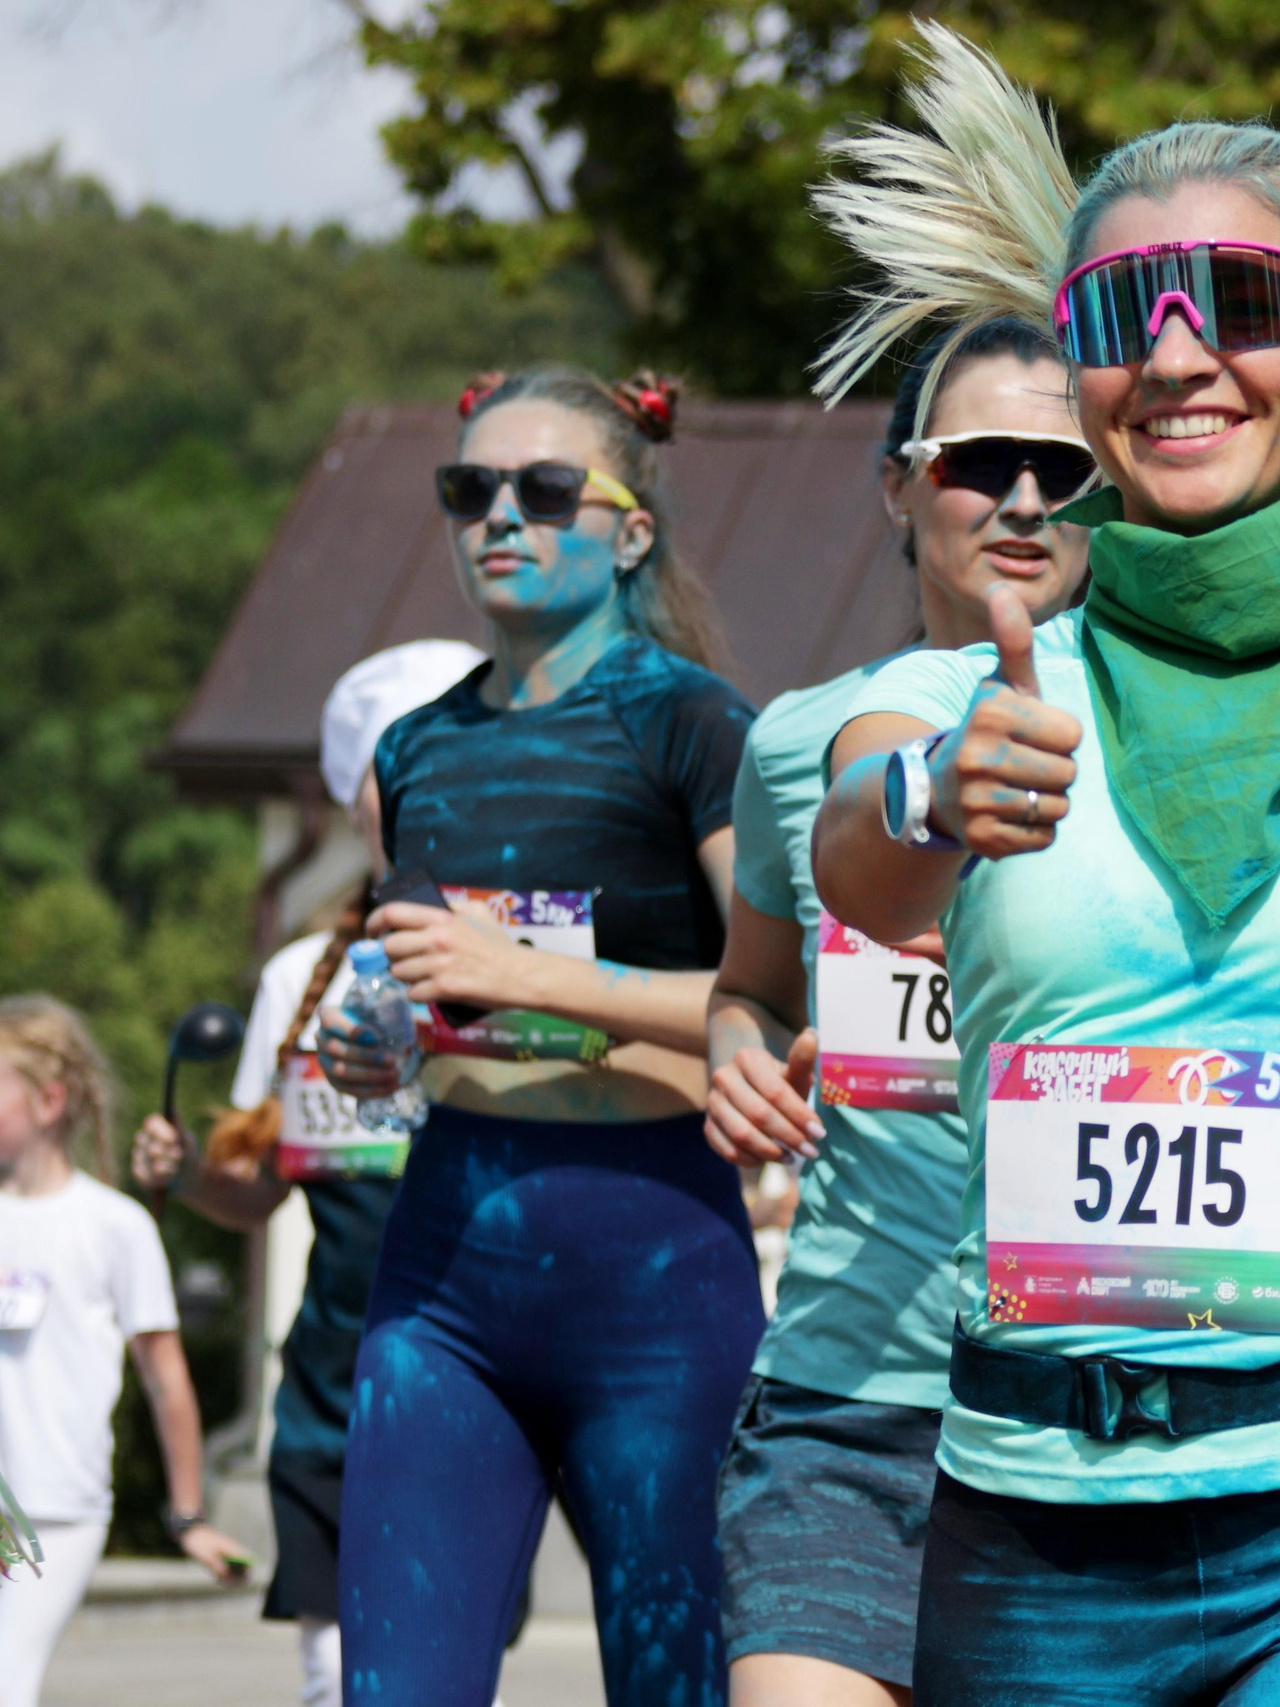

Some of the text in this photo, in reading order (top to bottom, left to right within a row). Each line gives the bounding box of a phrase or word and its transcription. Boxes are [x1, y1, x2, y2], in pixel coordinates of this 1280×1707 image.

[1023, 1047, 1130, 1080] КРАСОЧНЫЙ
[1038, 1073, 1110, 1103] ЗАБЕГ
[1073, 1122, 1246, 1227] 5215
